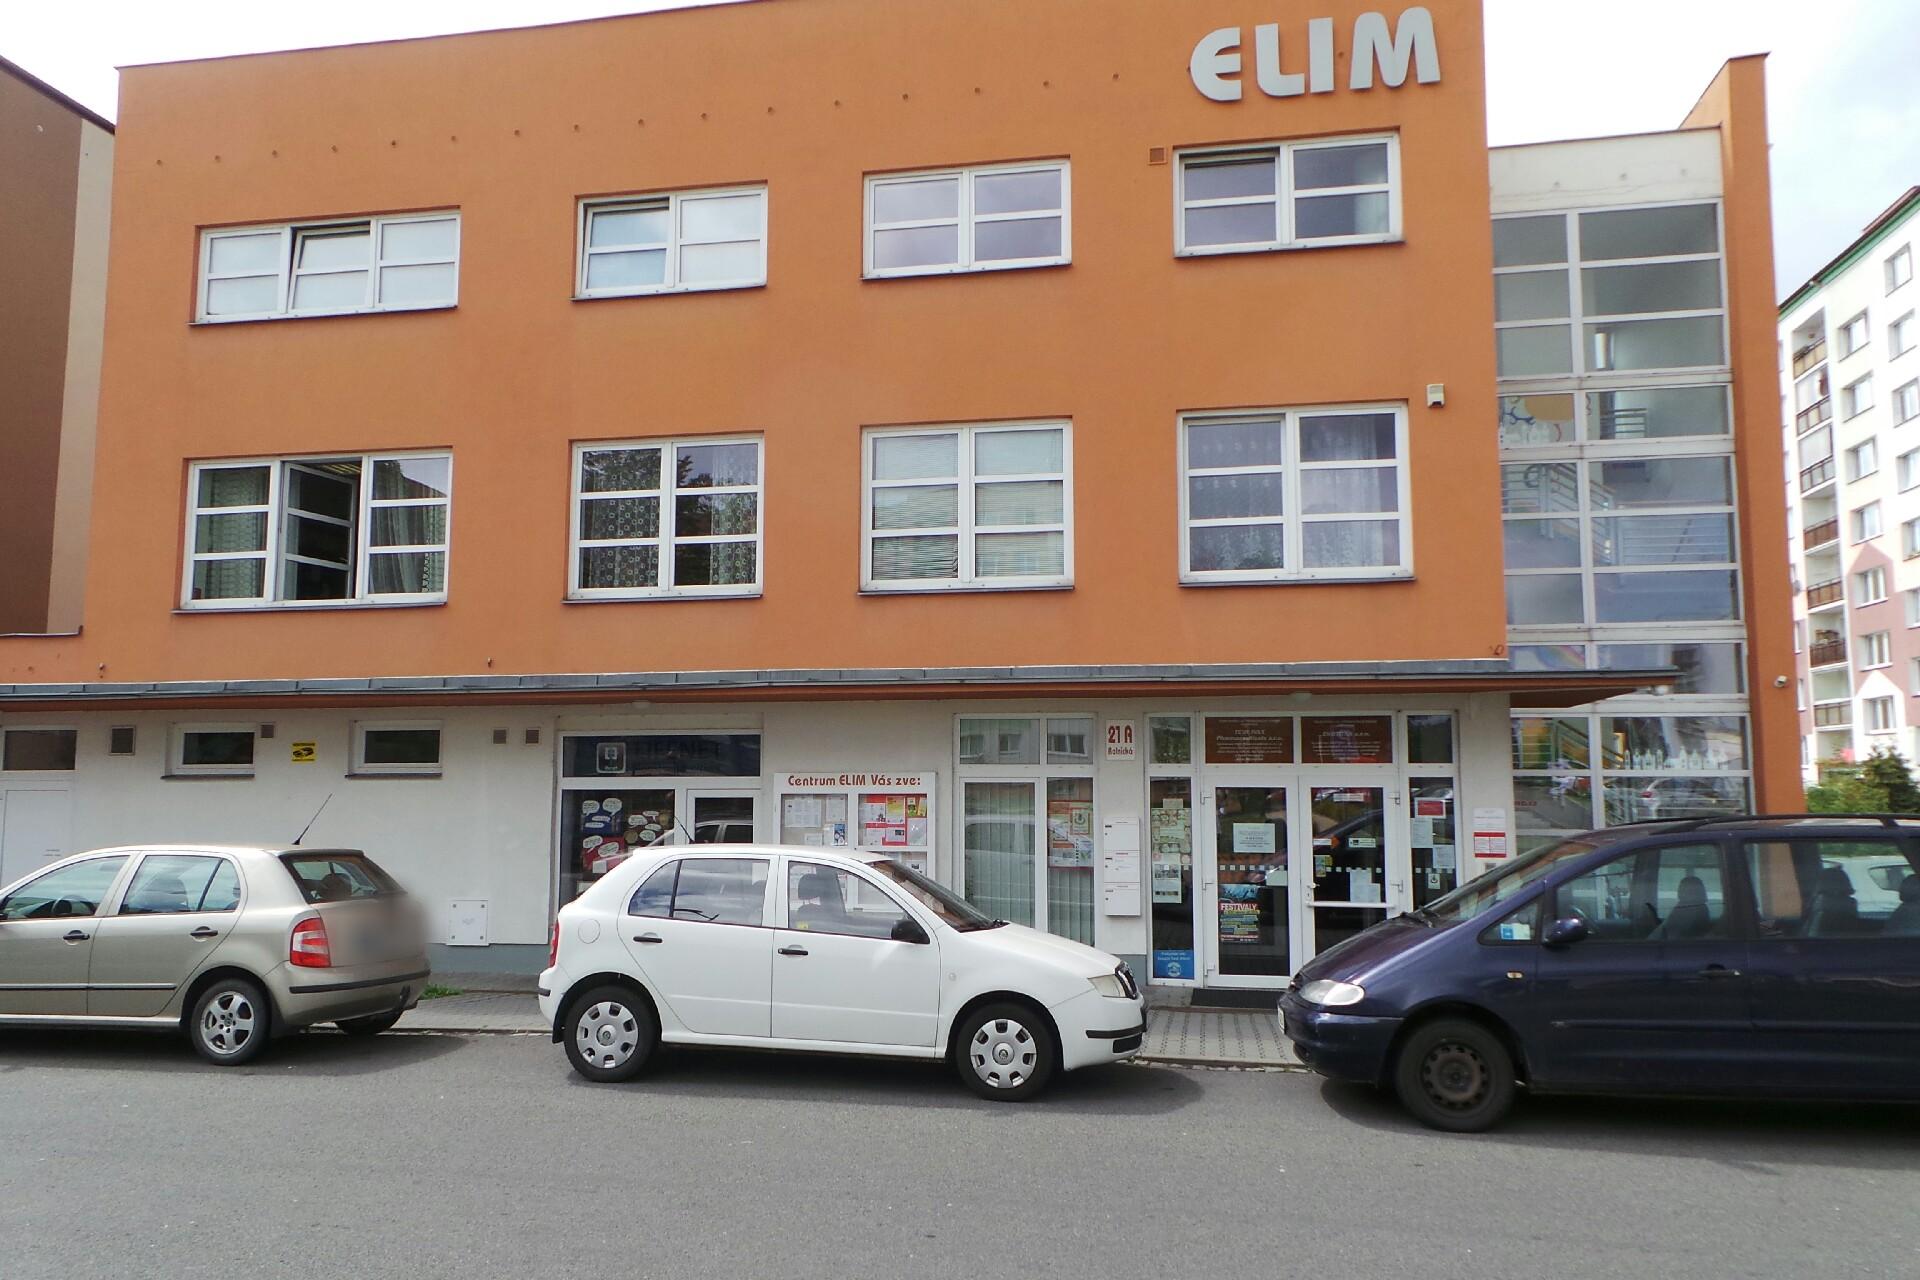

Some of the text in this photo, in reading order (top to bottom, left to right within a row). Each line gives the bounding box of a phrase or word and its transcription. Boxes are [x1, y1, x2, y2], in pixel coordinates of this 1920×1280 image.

[1190, 6, 1440, 101] ELIM
[1108, 724, 1133, 744] 21 A
[788, 774, 921, 787] Centrum ELIM Vás zve:
